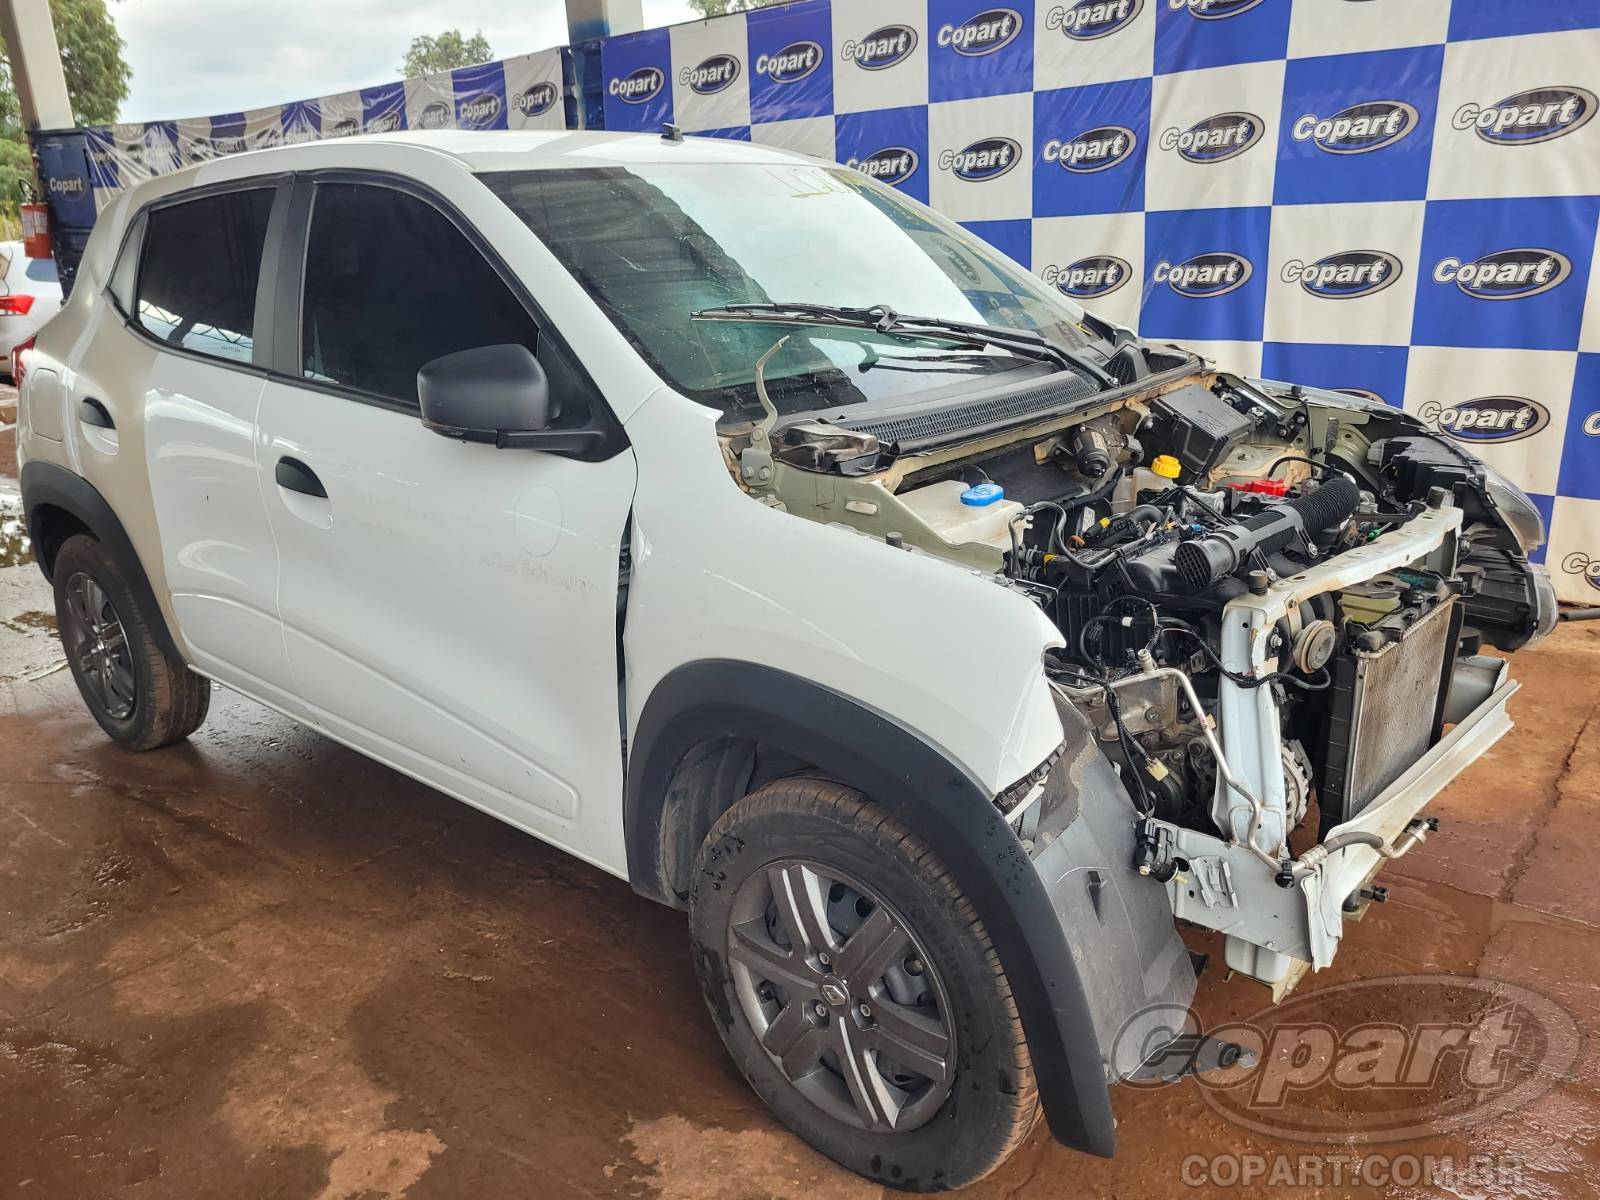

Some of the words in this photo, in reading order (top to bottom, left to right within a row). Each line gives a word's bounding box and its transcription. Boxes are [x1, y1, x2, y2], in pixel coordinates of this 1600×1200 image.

[937, 13, 1013, 48] Copart
[1045, 0, 1130, 32] Copart
[756, 45, 815, 77] Copart
[841, 30, 909, 63] Copart
[609, 72, 657, 98] Copart
[679, 60, 734, 88] Copart
[460, 99, 496, 121] Copart
[512, 87, 550, 111] Copart
[1451, 92, 1580, 136] Copart
[1159, 120, 1251, 153] Copart
[1292, 107, 1405, 145] Copart
[938, 143, 1011, 173] Copart
[1043, 131, 1125, 166] Copart
[50, 177, 83, 194] Copart
[1041, 261, 1118, 290] Copart
[1152, 258, 1241, 290] Copart
[1280, 256, 1388, 289] Copart
[1432, 254, 1556, 289] Copart
[1417, 400, 1533, 431] Copart
